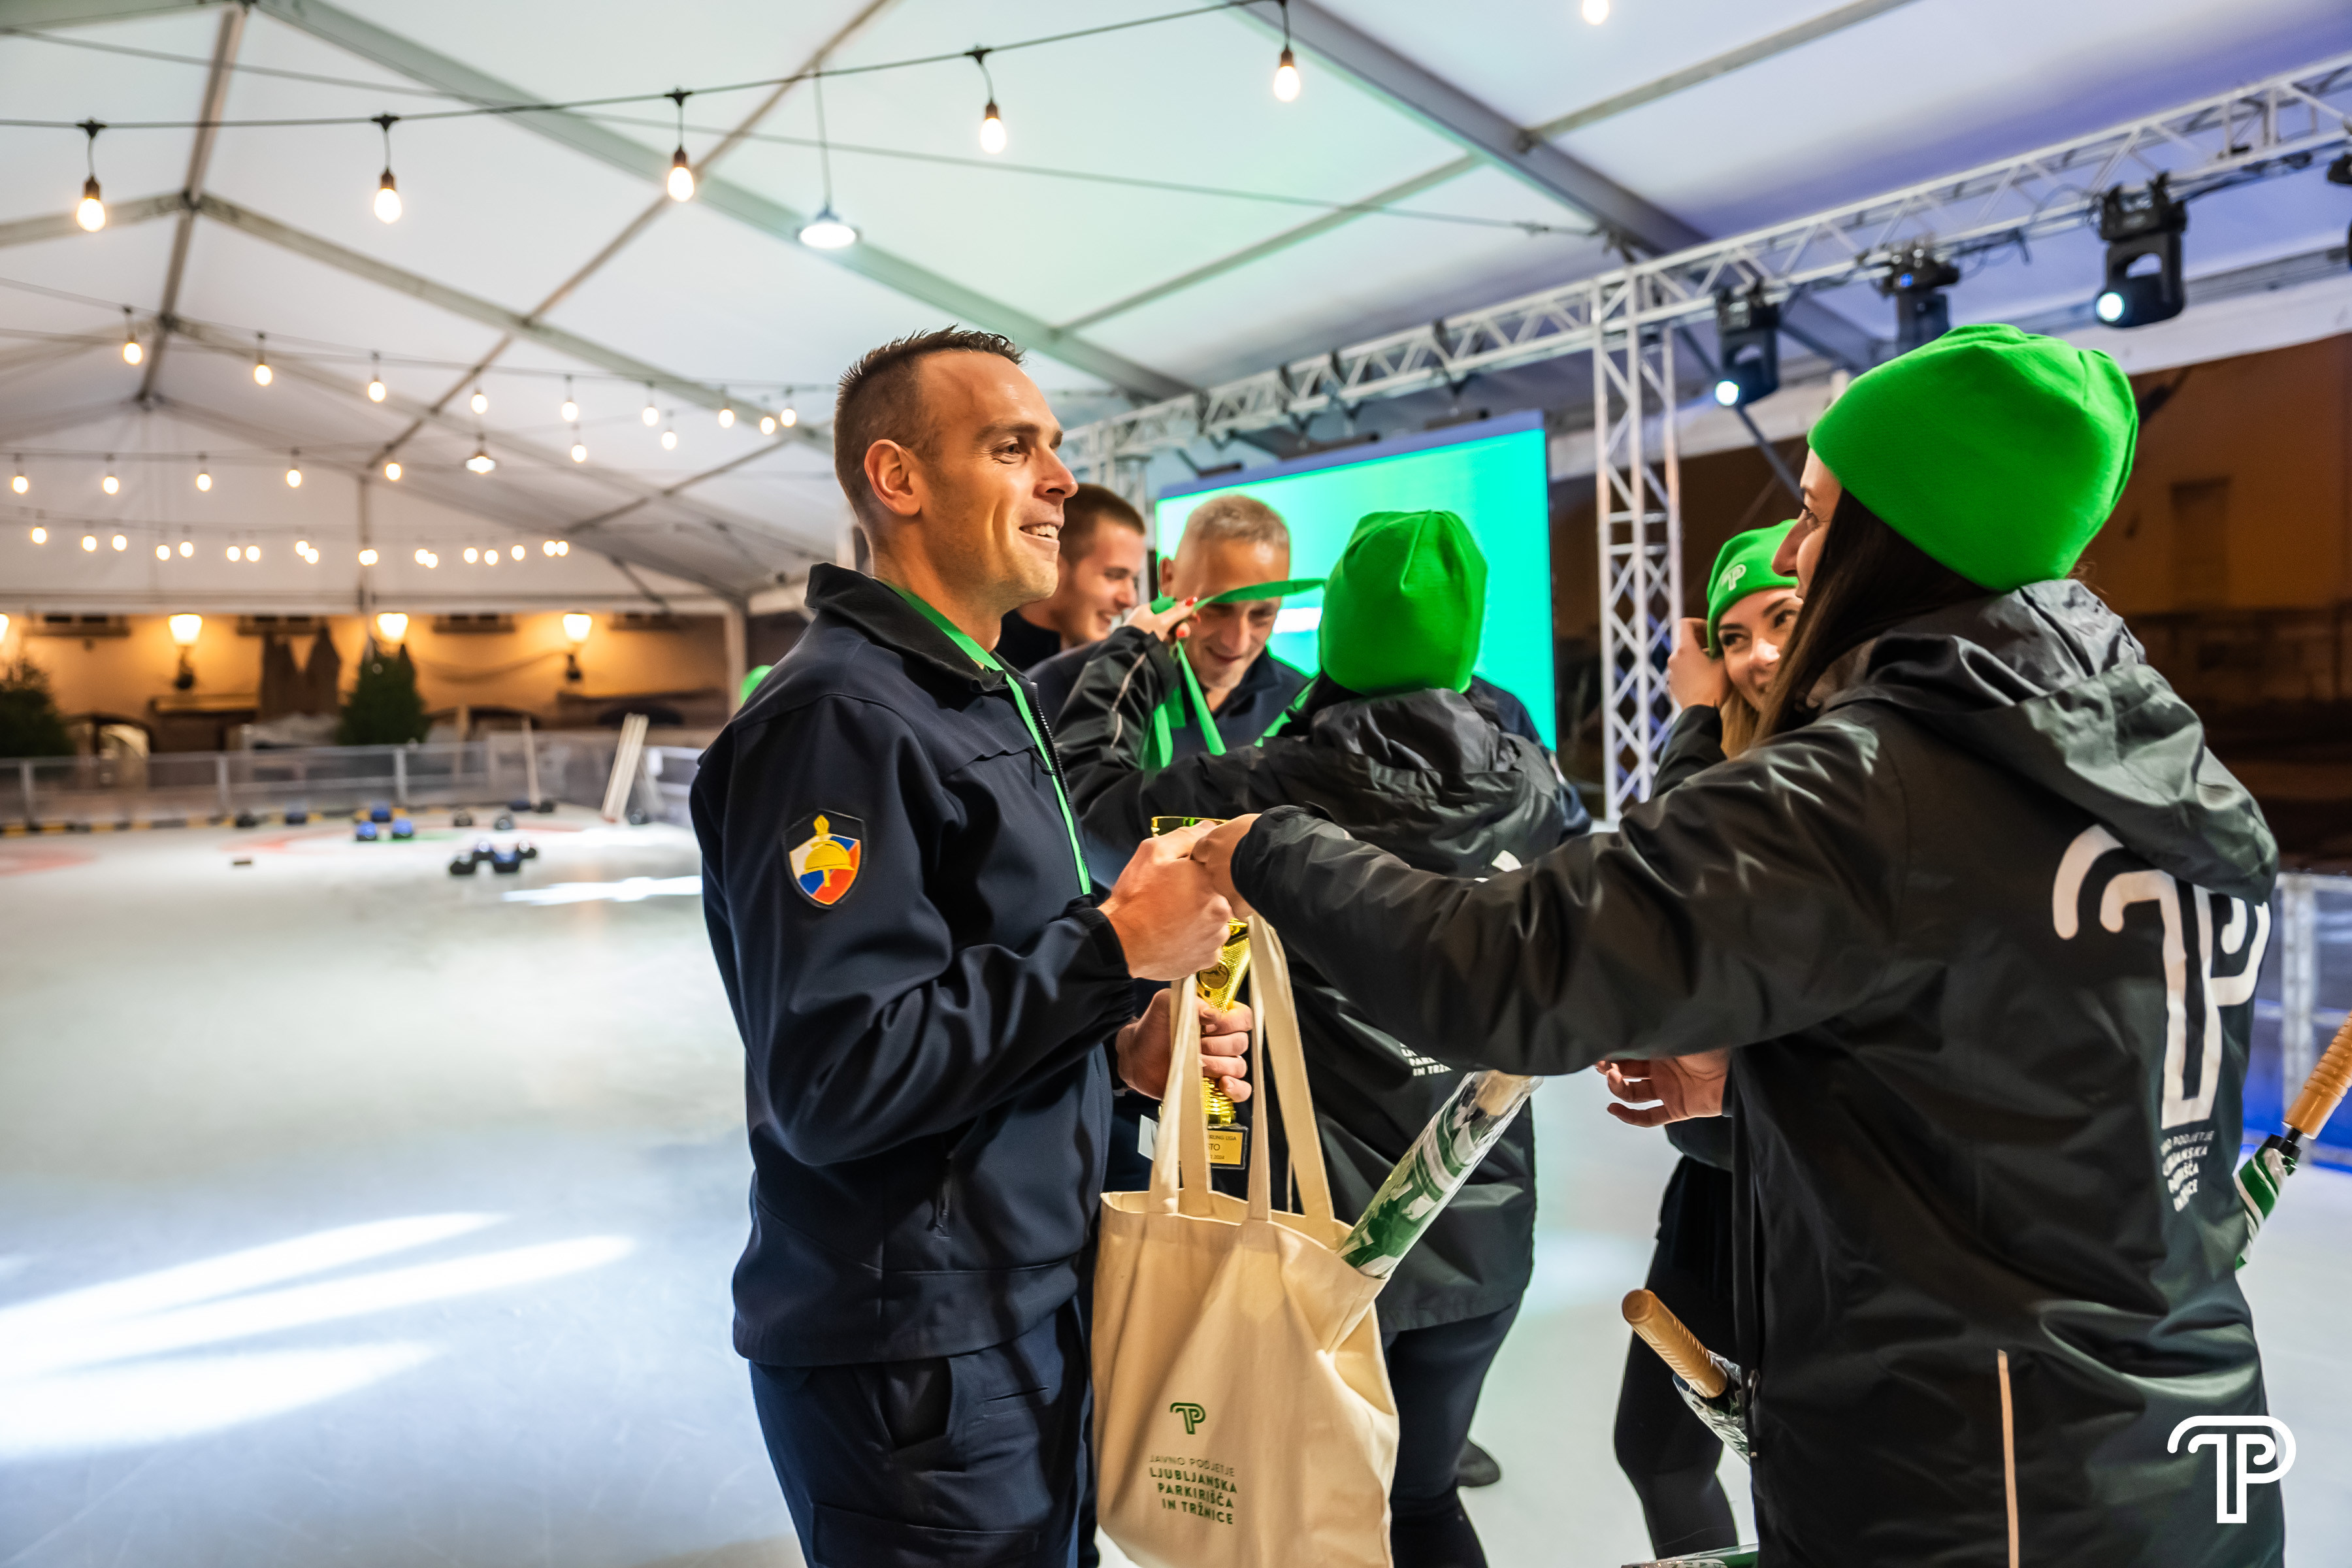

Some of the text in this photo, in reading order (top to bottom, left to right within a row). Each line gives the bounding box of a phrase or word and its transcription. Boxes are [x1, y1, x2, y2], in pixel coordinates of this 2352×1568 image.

[1149, 1467, 1237, 1494] LJUBLJANSKA
[1158, 1482, 1234, 1509] PARKIRIŠČA
[1162, 1498, 1233, 1525] IN TRŽNICE
